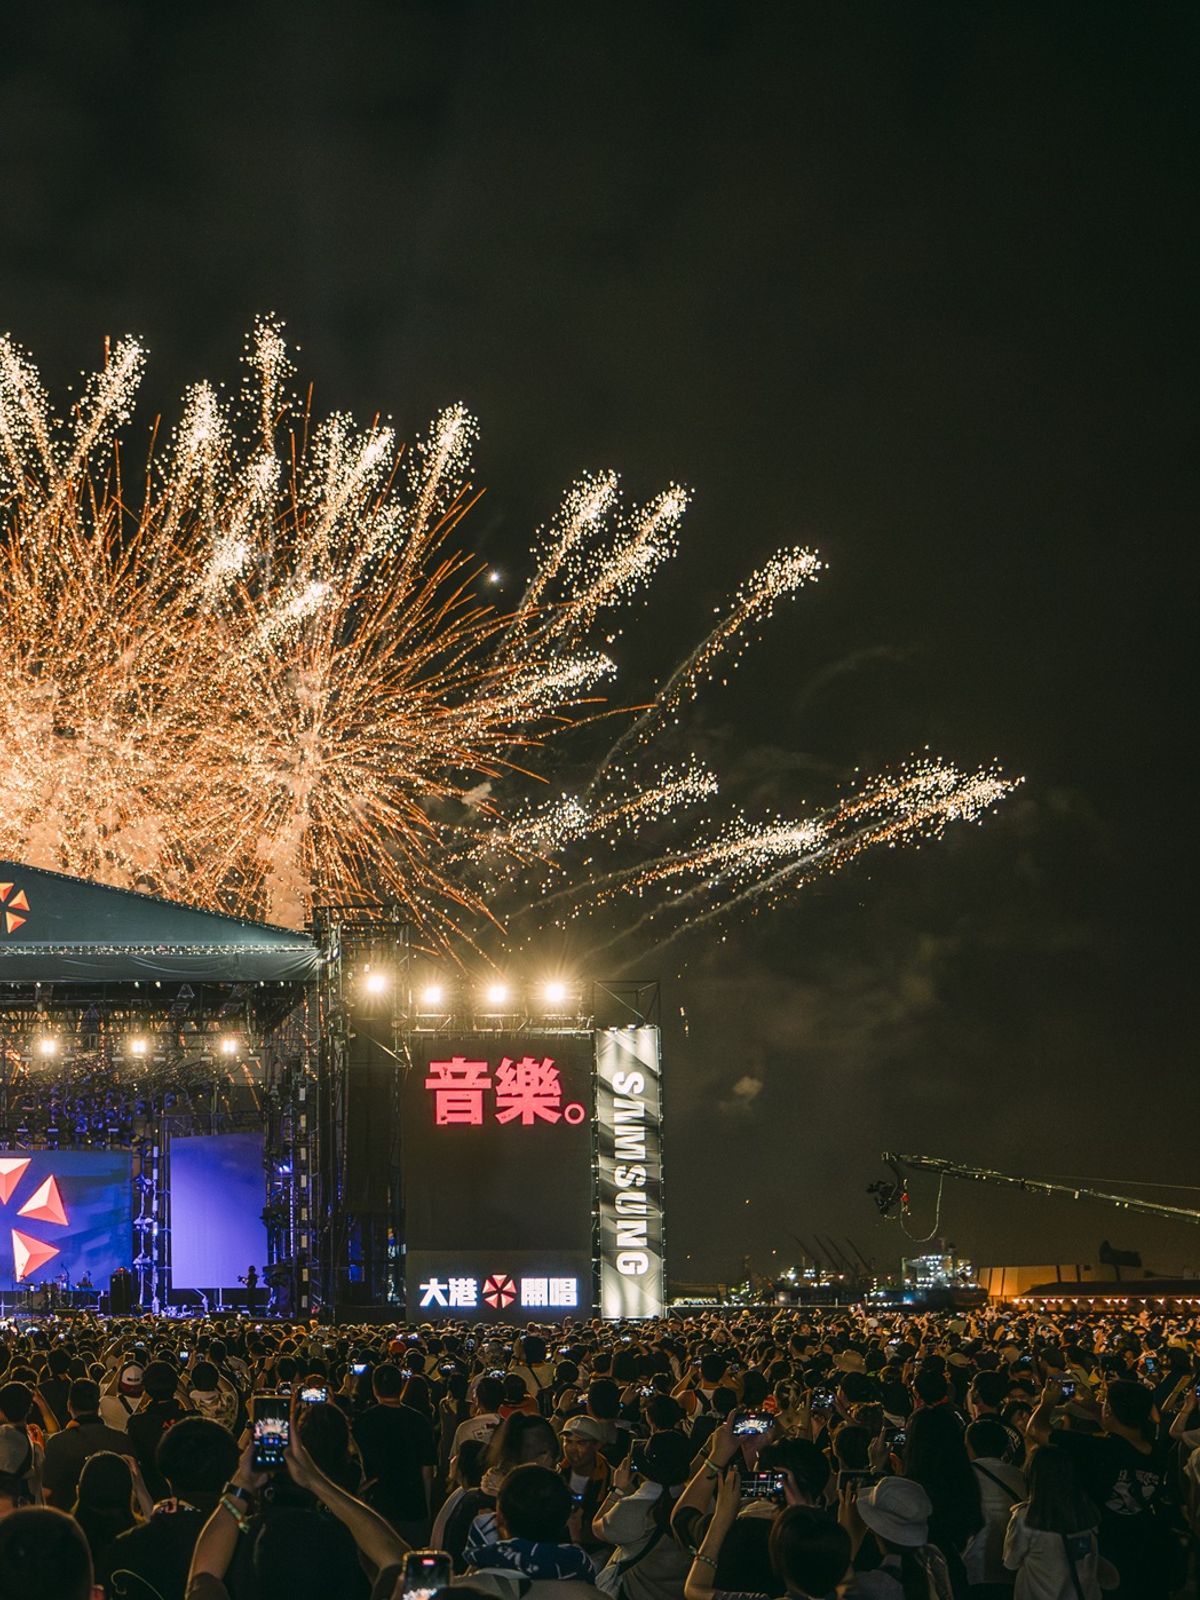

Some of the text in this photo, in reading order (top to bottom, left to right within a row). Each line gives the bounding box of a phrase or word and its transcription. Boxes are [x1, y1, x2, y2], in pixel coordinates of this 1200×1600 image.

[425, 1056, 585, 1125] 音樂。
[612, 1071, 649, 1275] SAMSUNG
[419, 1278, 477, 1307] 大港
